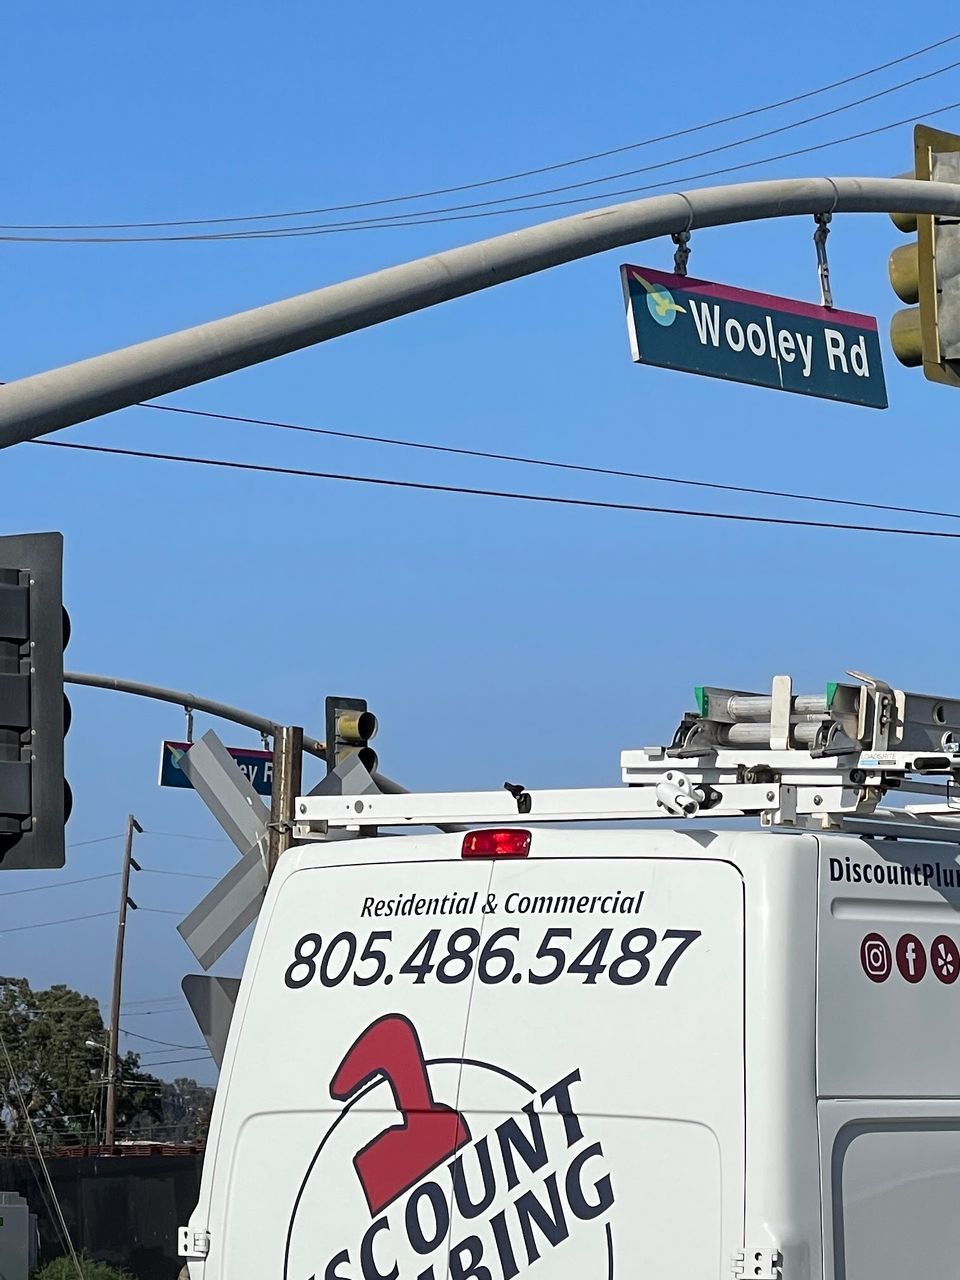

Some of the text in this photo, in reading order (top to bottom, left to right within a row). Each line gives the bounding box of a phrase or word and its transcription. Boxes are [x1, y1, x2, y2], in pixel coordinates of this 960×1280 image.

[689, 300, 870, 377] Wooley Rd
[361, 891, 645, 918] Residential & Commercial
[284, 927, 702, 988] 805.486.5487
